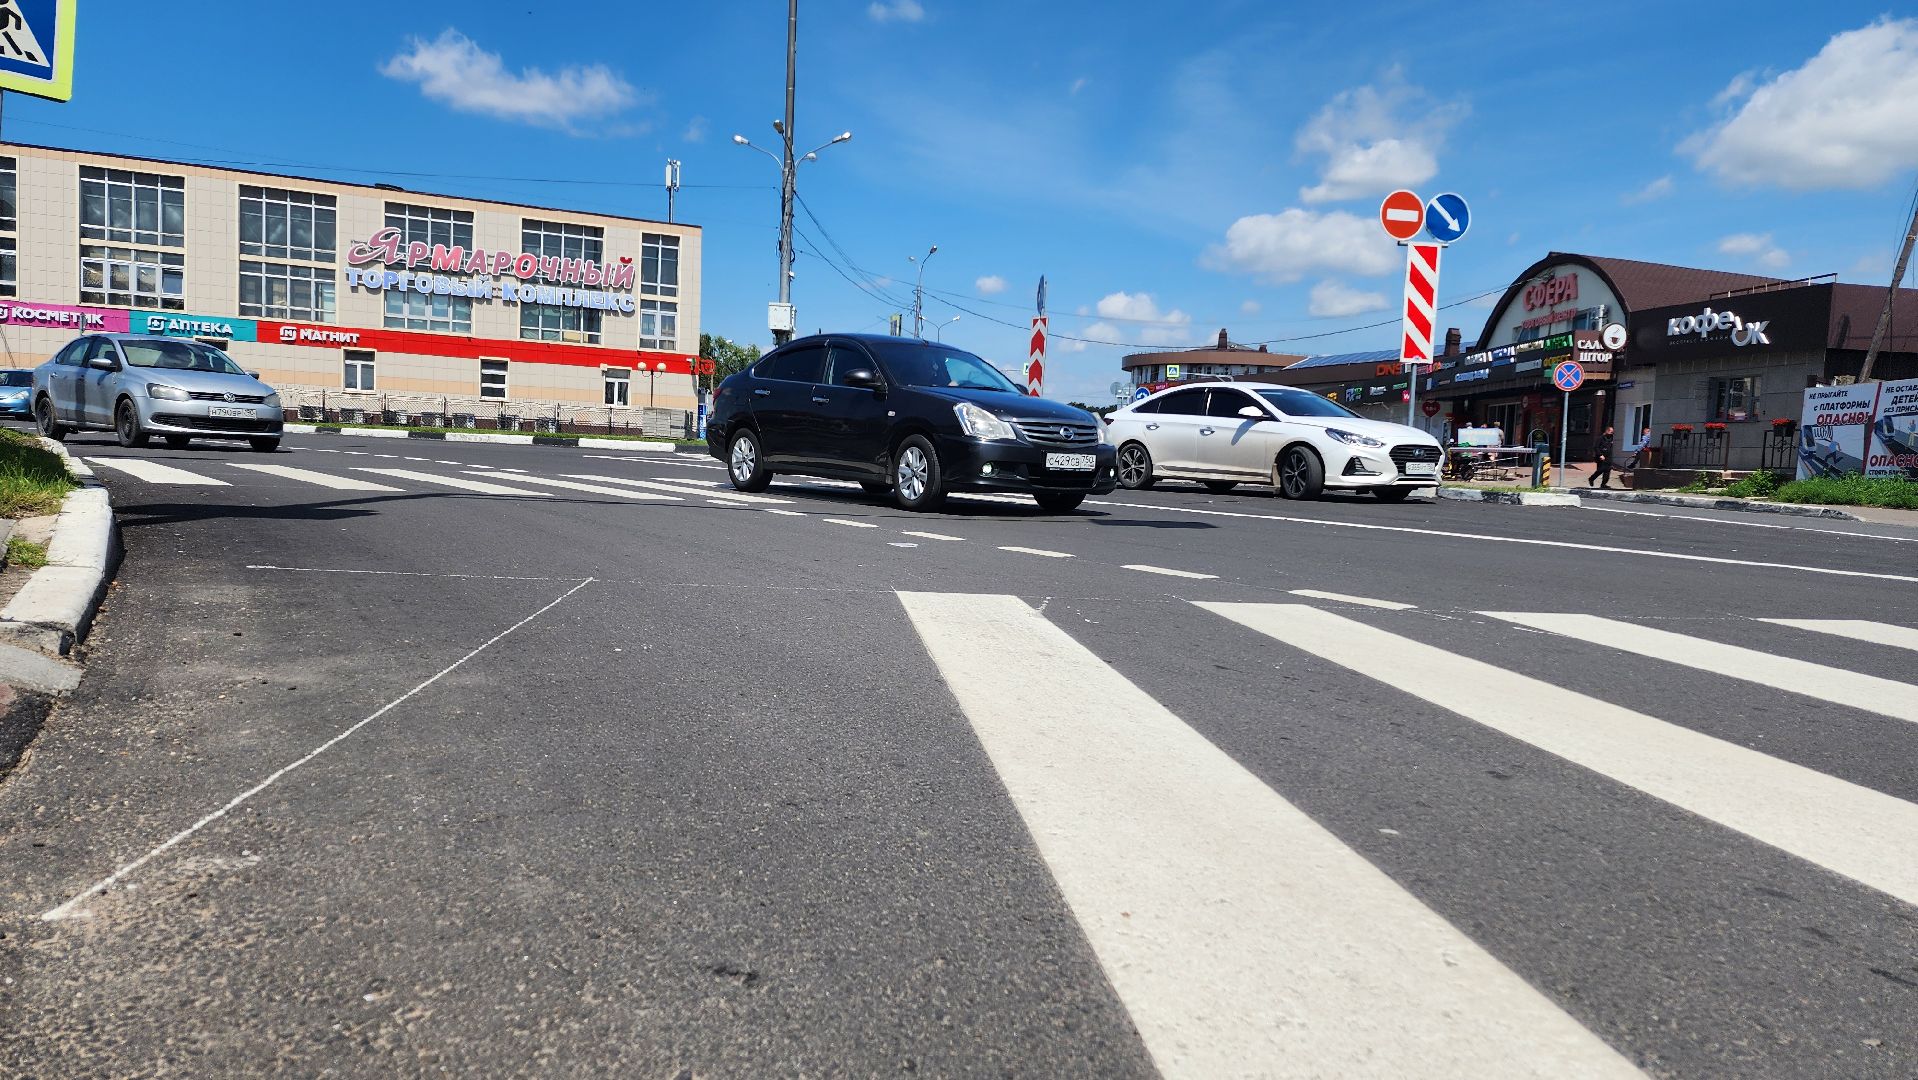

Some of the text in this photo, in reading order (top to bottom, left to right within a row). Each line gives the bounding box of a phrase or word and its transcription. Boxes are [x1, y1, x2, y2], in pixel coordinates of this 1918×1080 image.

[344, 267, 636, 313] ТОРГОВЫЙ КОМПЛЕКС
[1523, 273, 1579, 312] СФЕРА
[168, 319, 233, 335] АПТЕКА
[300, 328, 360, 344] МАГНИТ
[1577, 339, 1604, 349] САЛ
[1578, 352, 1613, 363] ШТОР
[1376, 362, 1402, 377] DNS
[1817, 390, 1848, 399] ПРЫГАЙТЕ
[1820, 400, 1871, 411] ПЛАТФОРМЫ
[1816, 411, 1870, 426] ОПАСНО!
